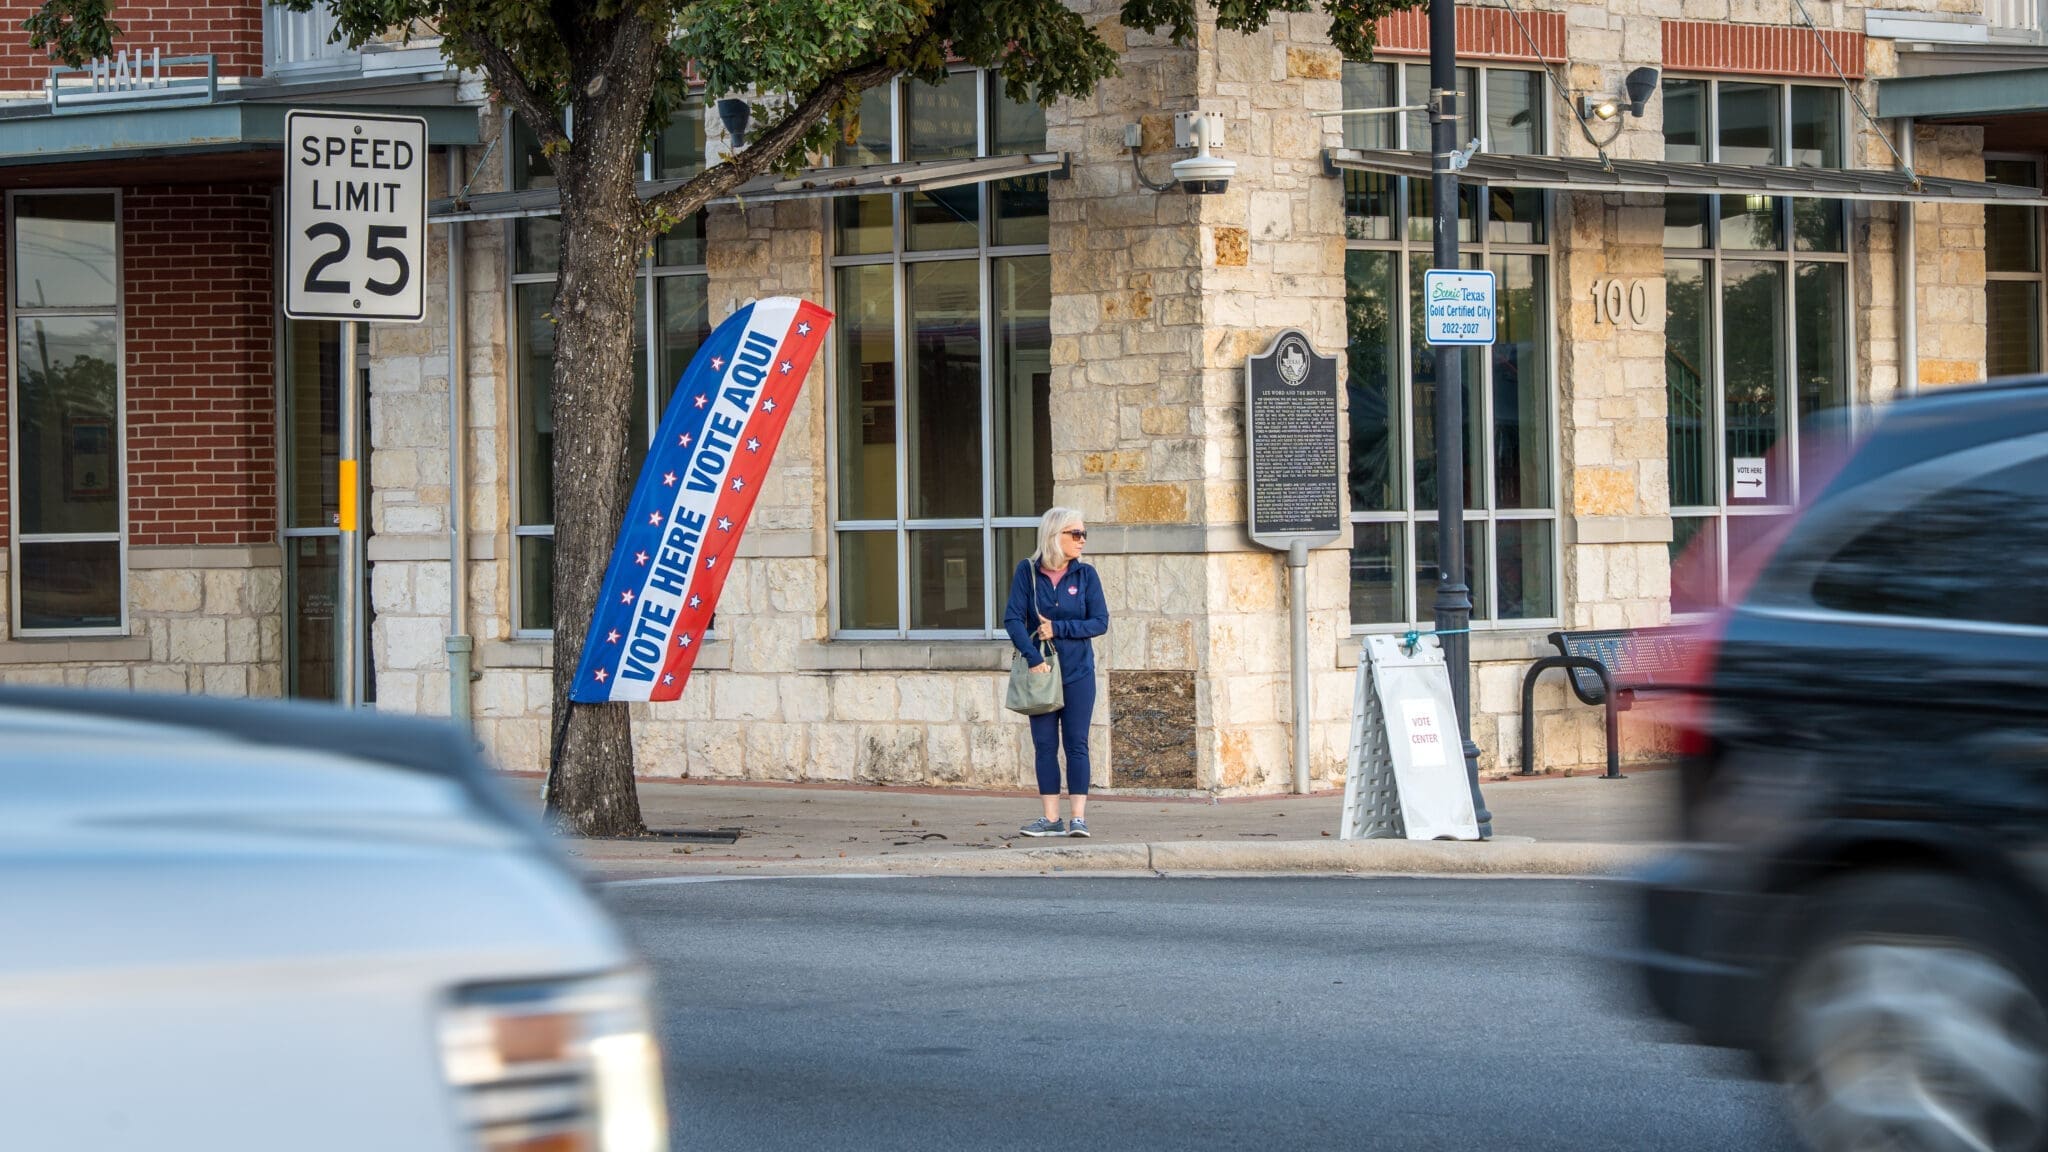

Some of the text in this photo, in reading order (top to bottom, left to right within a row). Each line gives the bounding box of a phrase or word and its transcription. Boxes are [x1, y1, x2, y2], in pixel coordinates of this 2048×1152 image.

[92, 46, 169, 93] HALL
[301, 135, 414, 170] SPEED
[312, 179, 401, 213] LIMIT
[304, 222, 410, 296] 25
[1432, 281, 1485, 301] Scenic Texas
[1590, 279, 1649, 326] 100
[1430, 304, 1491, 320] Gold Certified City
[1441, 322, 1480, 334] 2022-2027
[1737, 466, 1763, 474] VOTE HERE
[621, 600, 676, 683] VOTE
[650, 505, 706, 597] HERE
[687, 411, 745, 495] VOTE
[722, 329, 778, 414] AQUI
[1411, 716, 1431, 727] VOTE
[1411, 733, 1439, 744] CENTER
